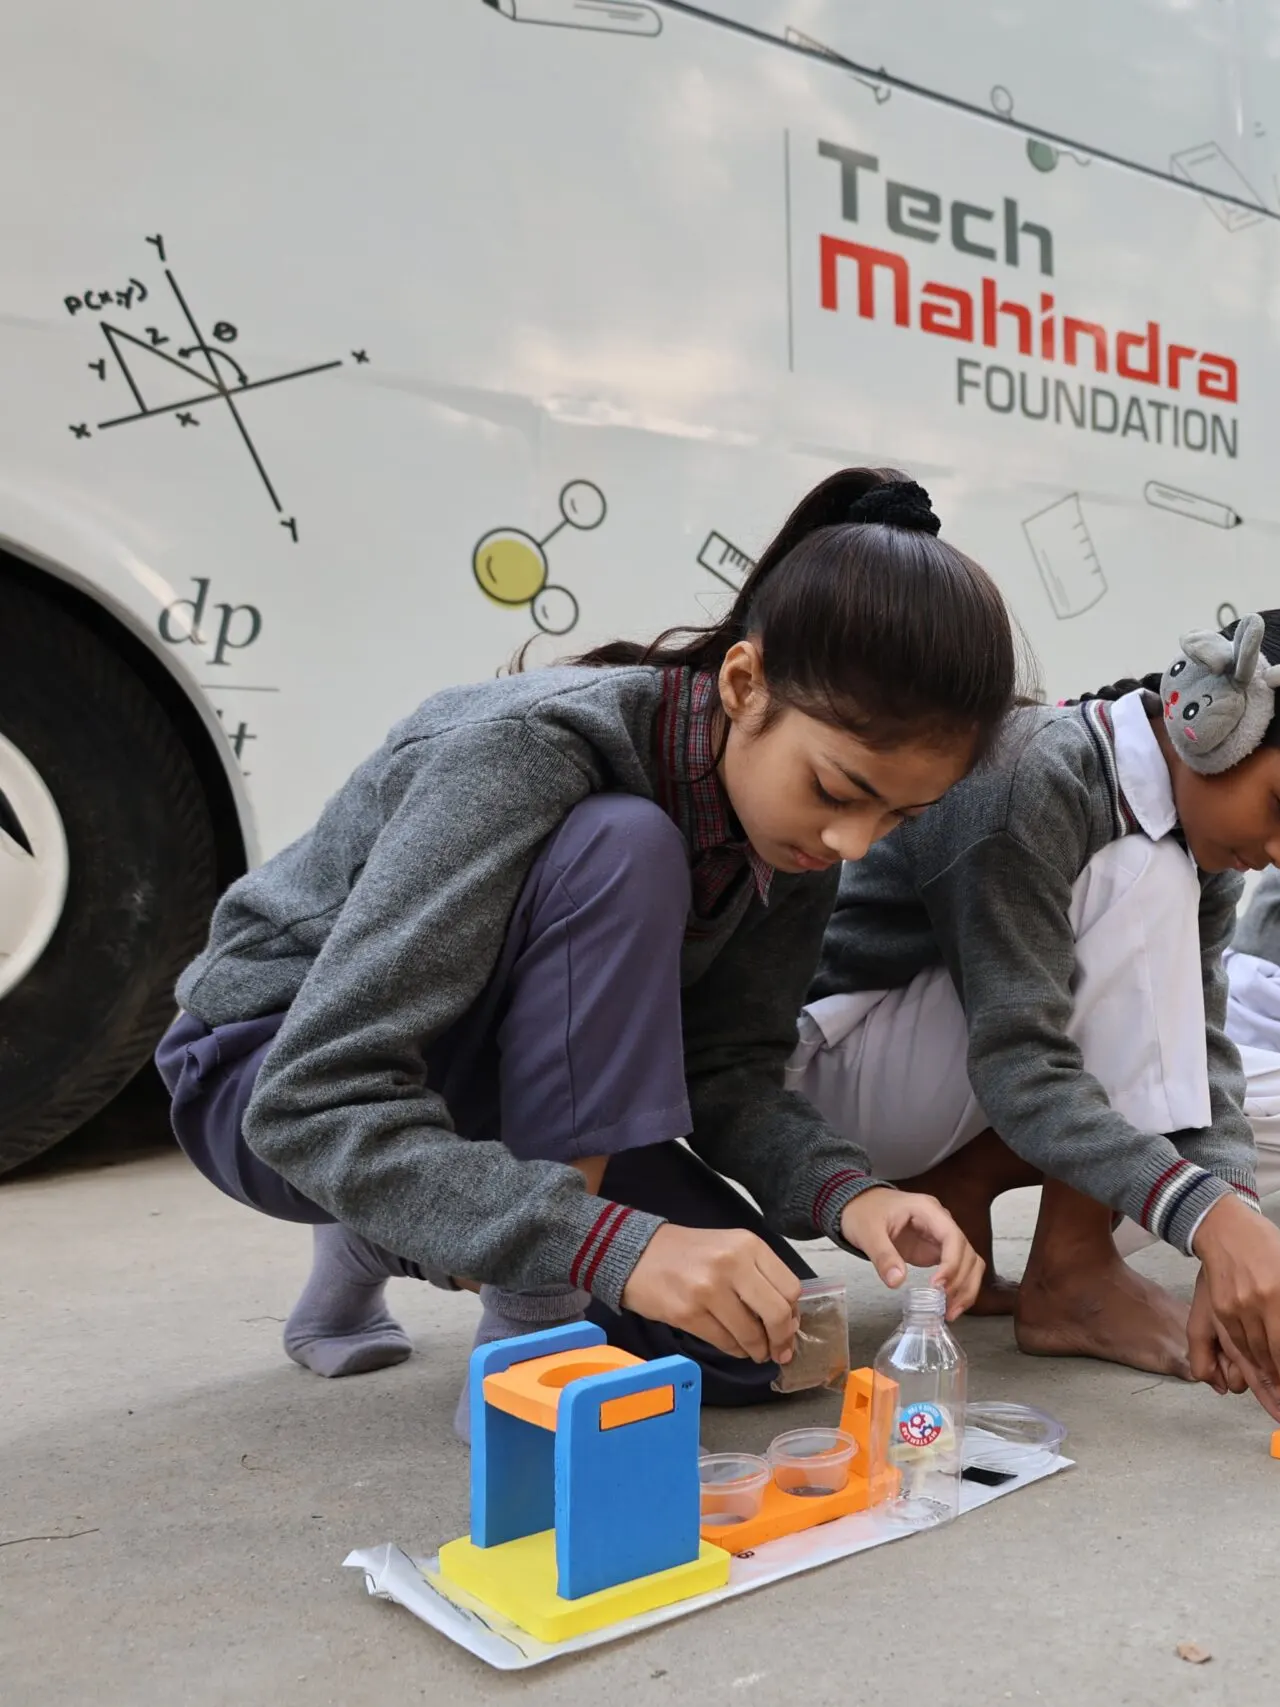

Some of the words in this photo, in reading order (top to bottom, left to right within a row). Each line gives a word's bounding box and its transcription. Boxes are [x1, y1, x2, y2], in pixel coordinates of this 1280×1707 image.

[818, 138, 1054, 277] Tech
[819, 233, 1239, 404] Mahindra
[956, 356, 1239, 460] FOUNDATION
[157, 576, 263, 666] dp
